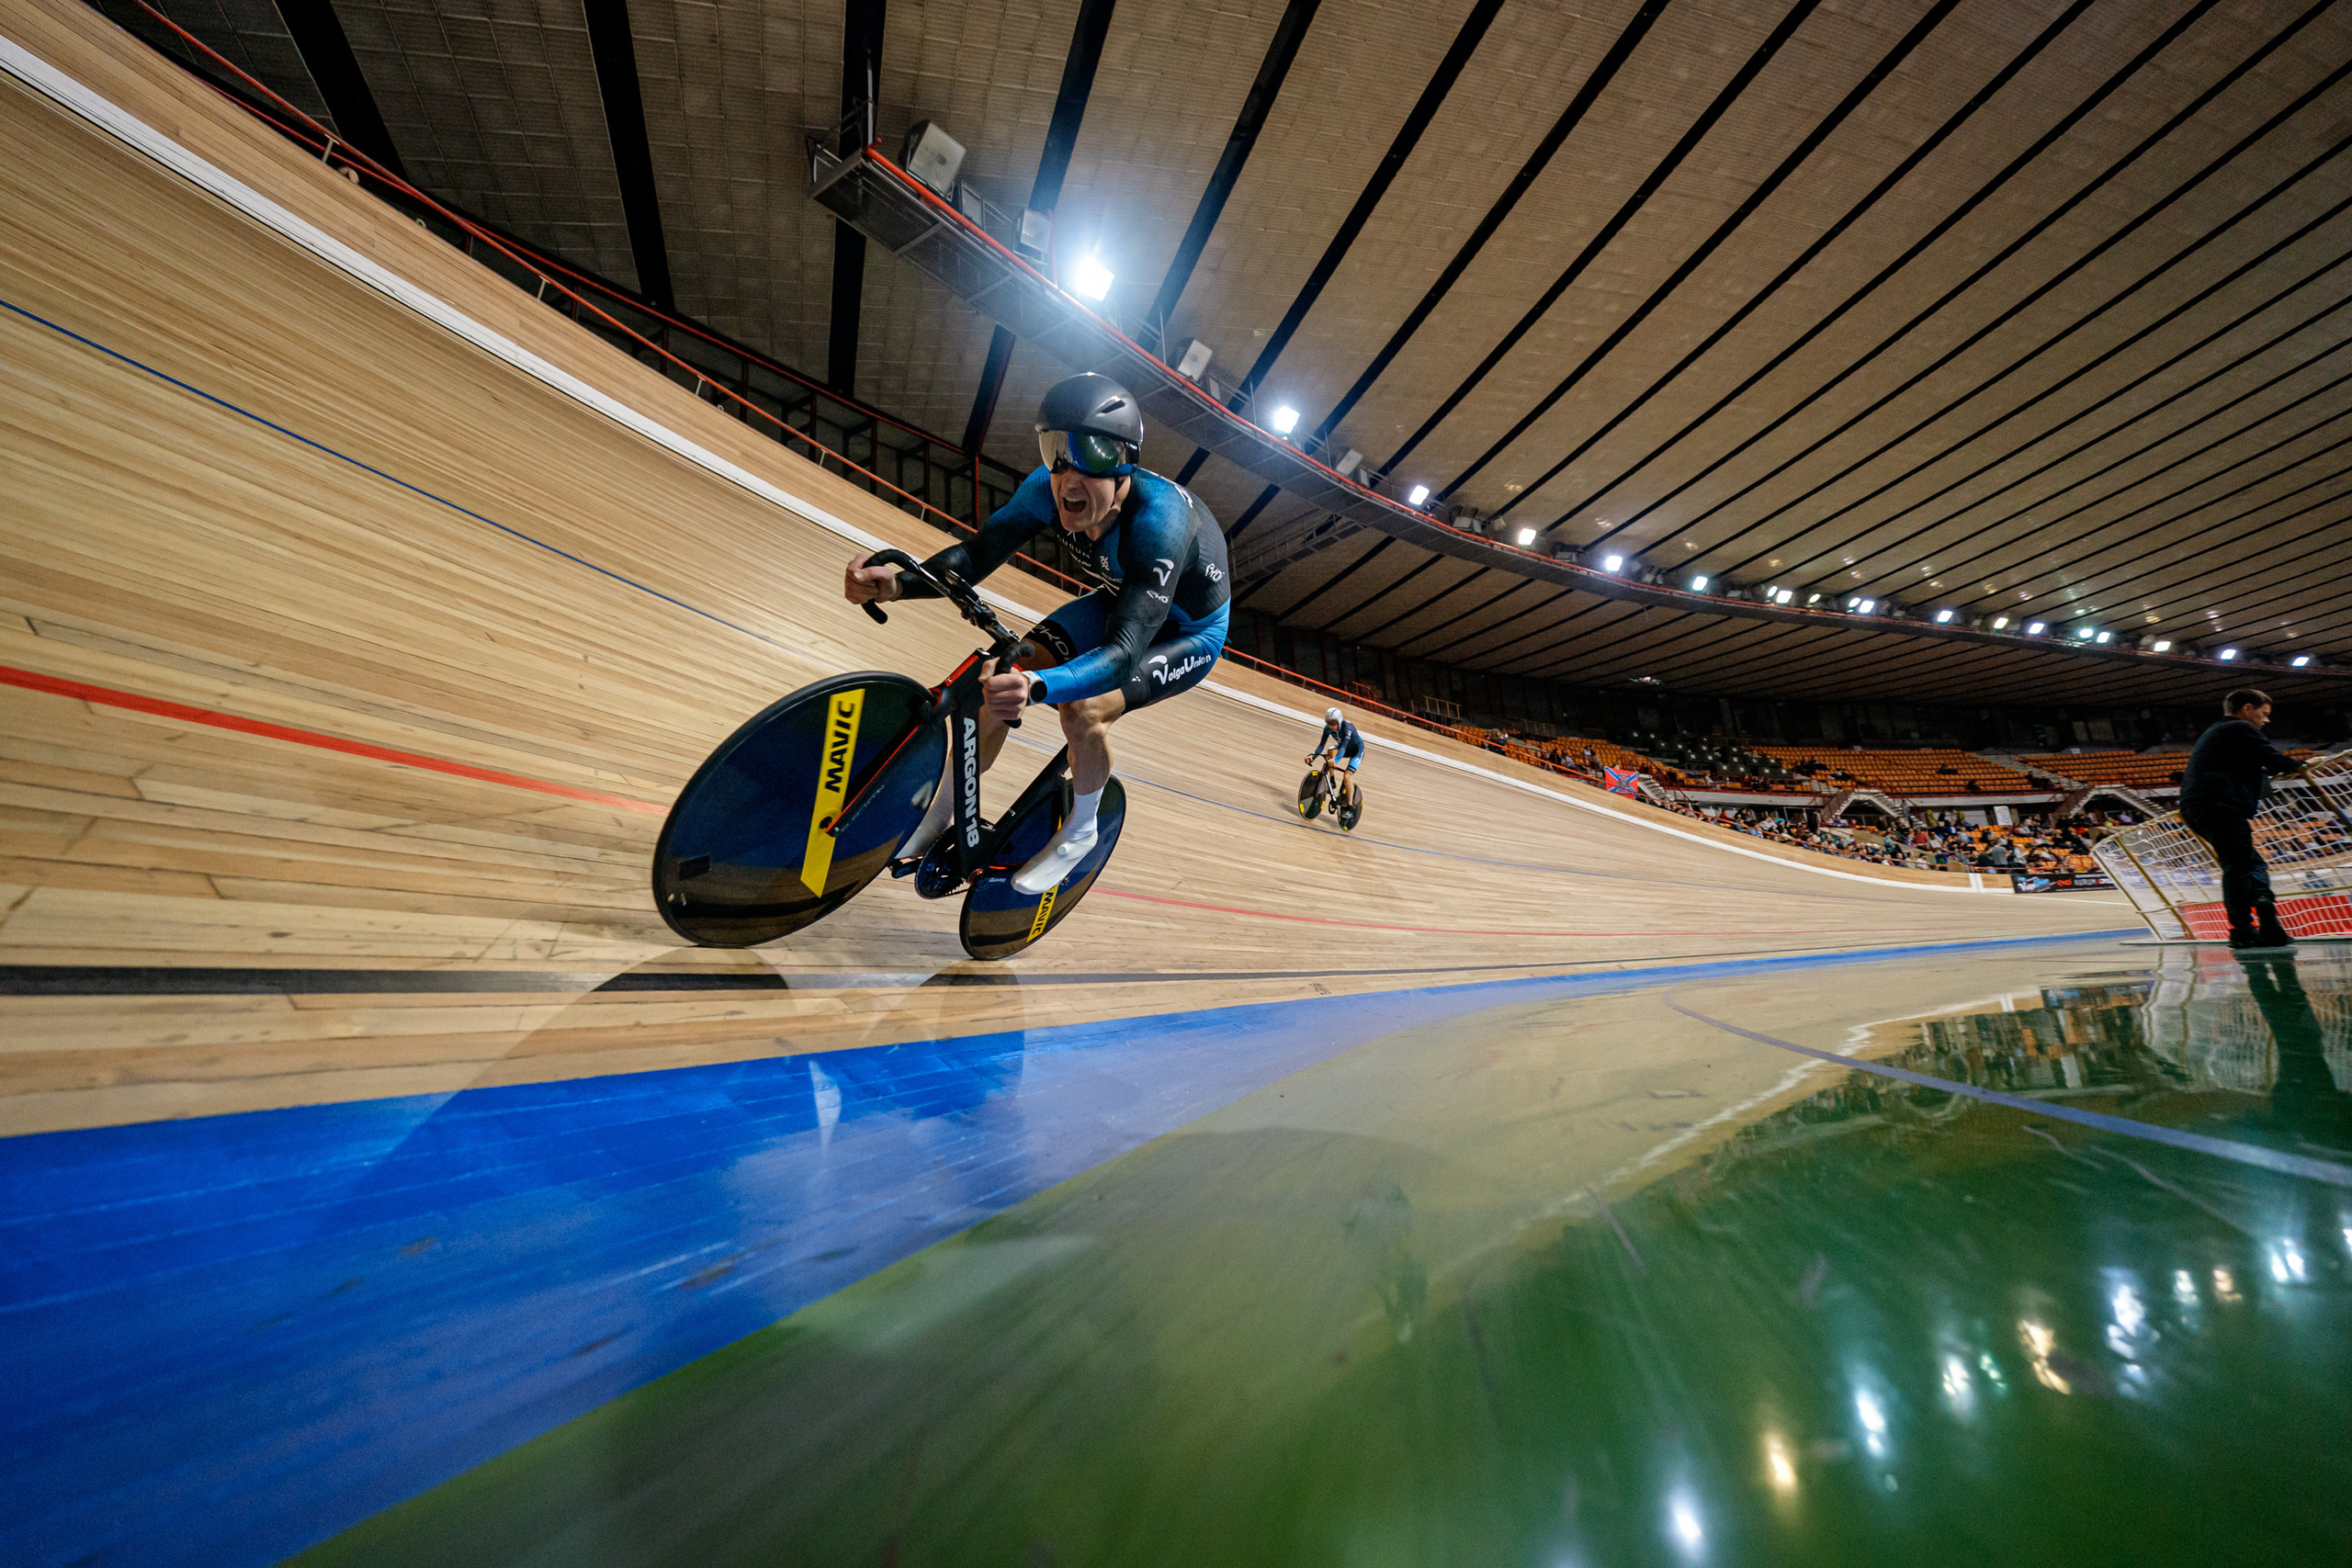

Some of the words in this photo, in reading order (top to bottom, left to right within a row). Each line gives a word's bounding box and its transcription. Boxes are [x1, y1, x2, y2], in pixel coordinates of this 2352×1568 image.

[1148, 654, 1212, 685] VolgaUnion
[824, 700, 856, 794] MAVIC
[963, 716, 978, 819] ARGON
[966, 817, 980, 848] 18
[1031, 891, 1055, 936] MAVIC
